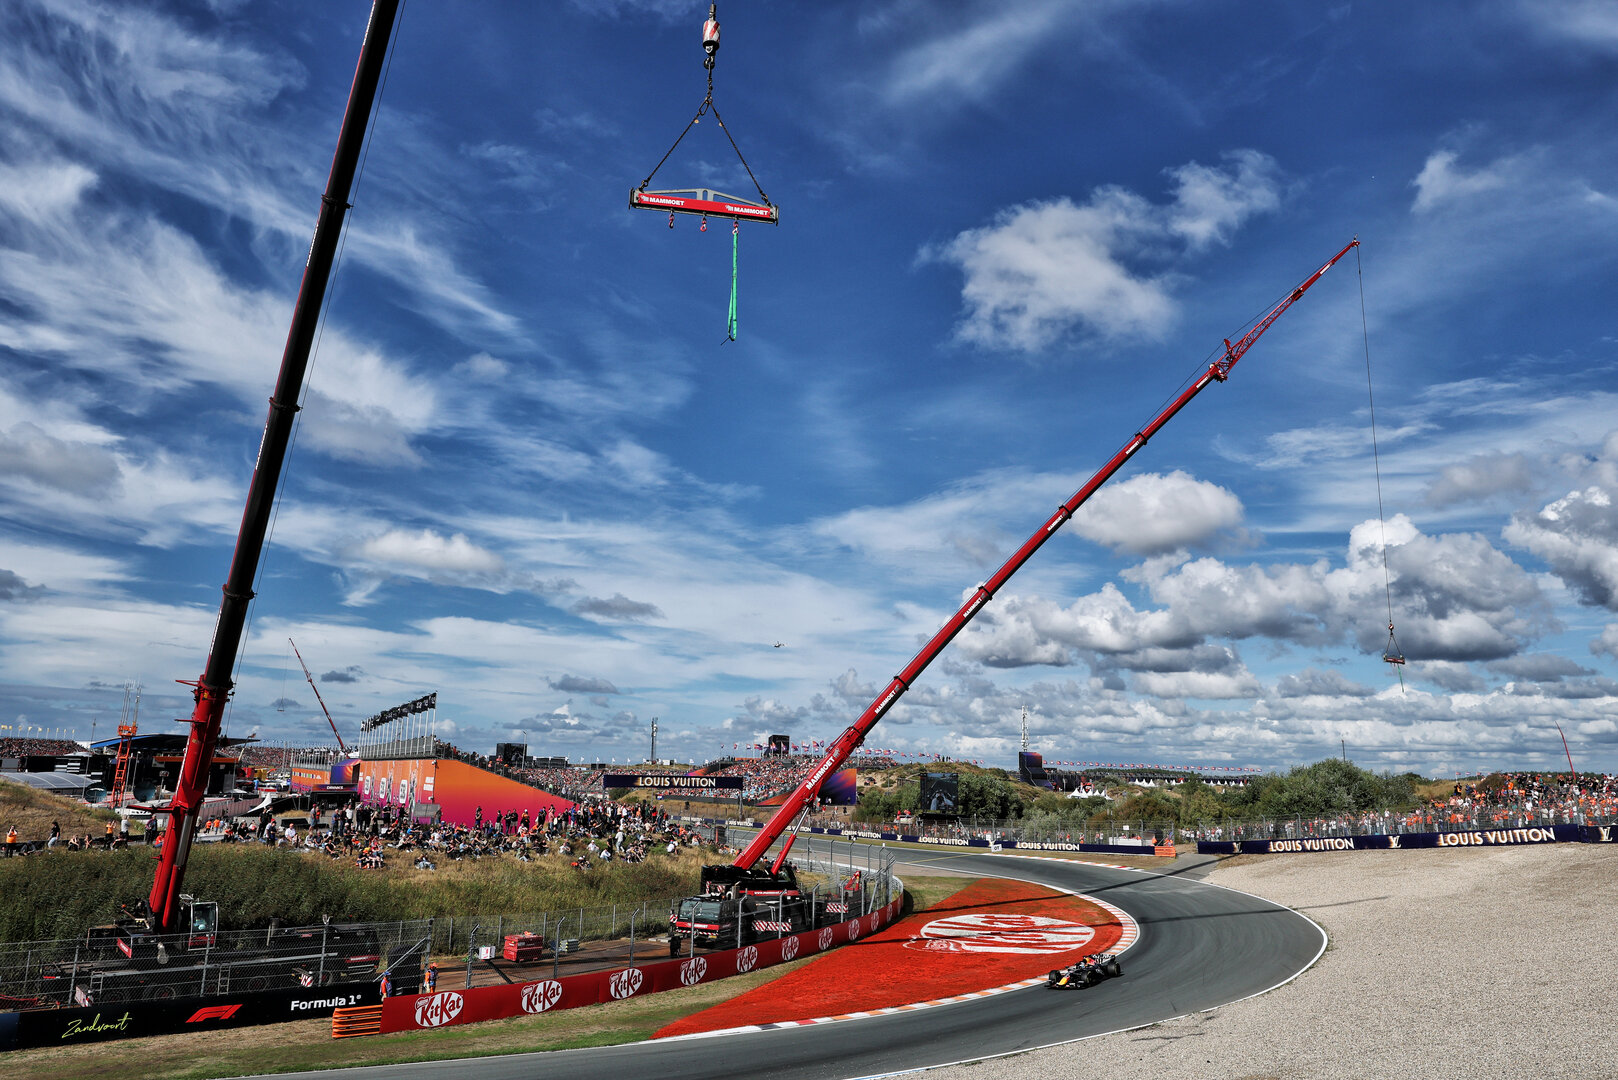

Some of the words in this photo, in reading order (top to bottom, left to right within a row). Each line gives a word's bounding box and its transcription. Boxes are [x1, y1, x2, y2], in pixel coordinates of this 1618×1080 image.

[649, 197, 685, 206] MAMMOET
[733, 206, 769, 216] MAMMOET
[805, 756, 835, 790] MAMMOET
[639, 777, 670, 787] LOUIS
[673, 777, 716, 787] VUITTON
[919, 836, 939, 844] LOUIS
[939, 837, 969, 846] VUITTON
[1270, 841, 1302, 852] LOUIS
[1304, 838, 1355, 851] VUITTON
[1439, 831, 1484, 847] LOUIS
[1487, 827, 1556, 845] VUITTON
[1017, 841, 1041, 850] LOUIS
[1042, 842, 1080, 851] VUITTON
[684, 958, 706, 985] KitKat
[614, 969, 642, 999] KitKat
[291, 996, 346, 1011] Formula
[525, 980, 561, 1013] KitKat
[420, 992, 462, 1027] KitKat
[61, 1012, 133, 1039] Zandvoort
